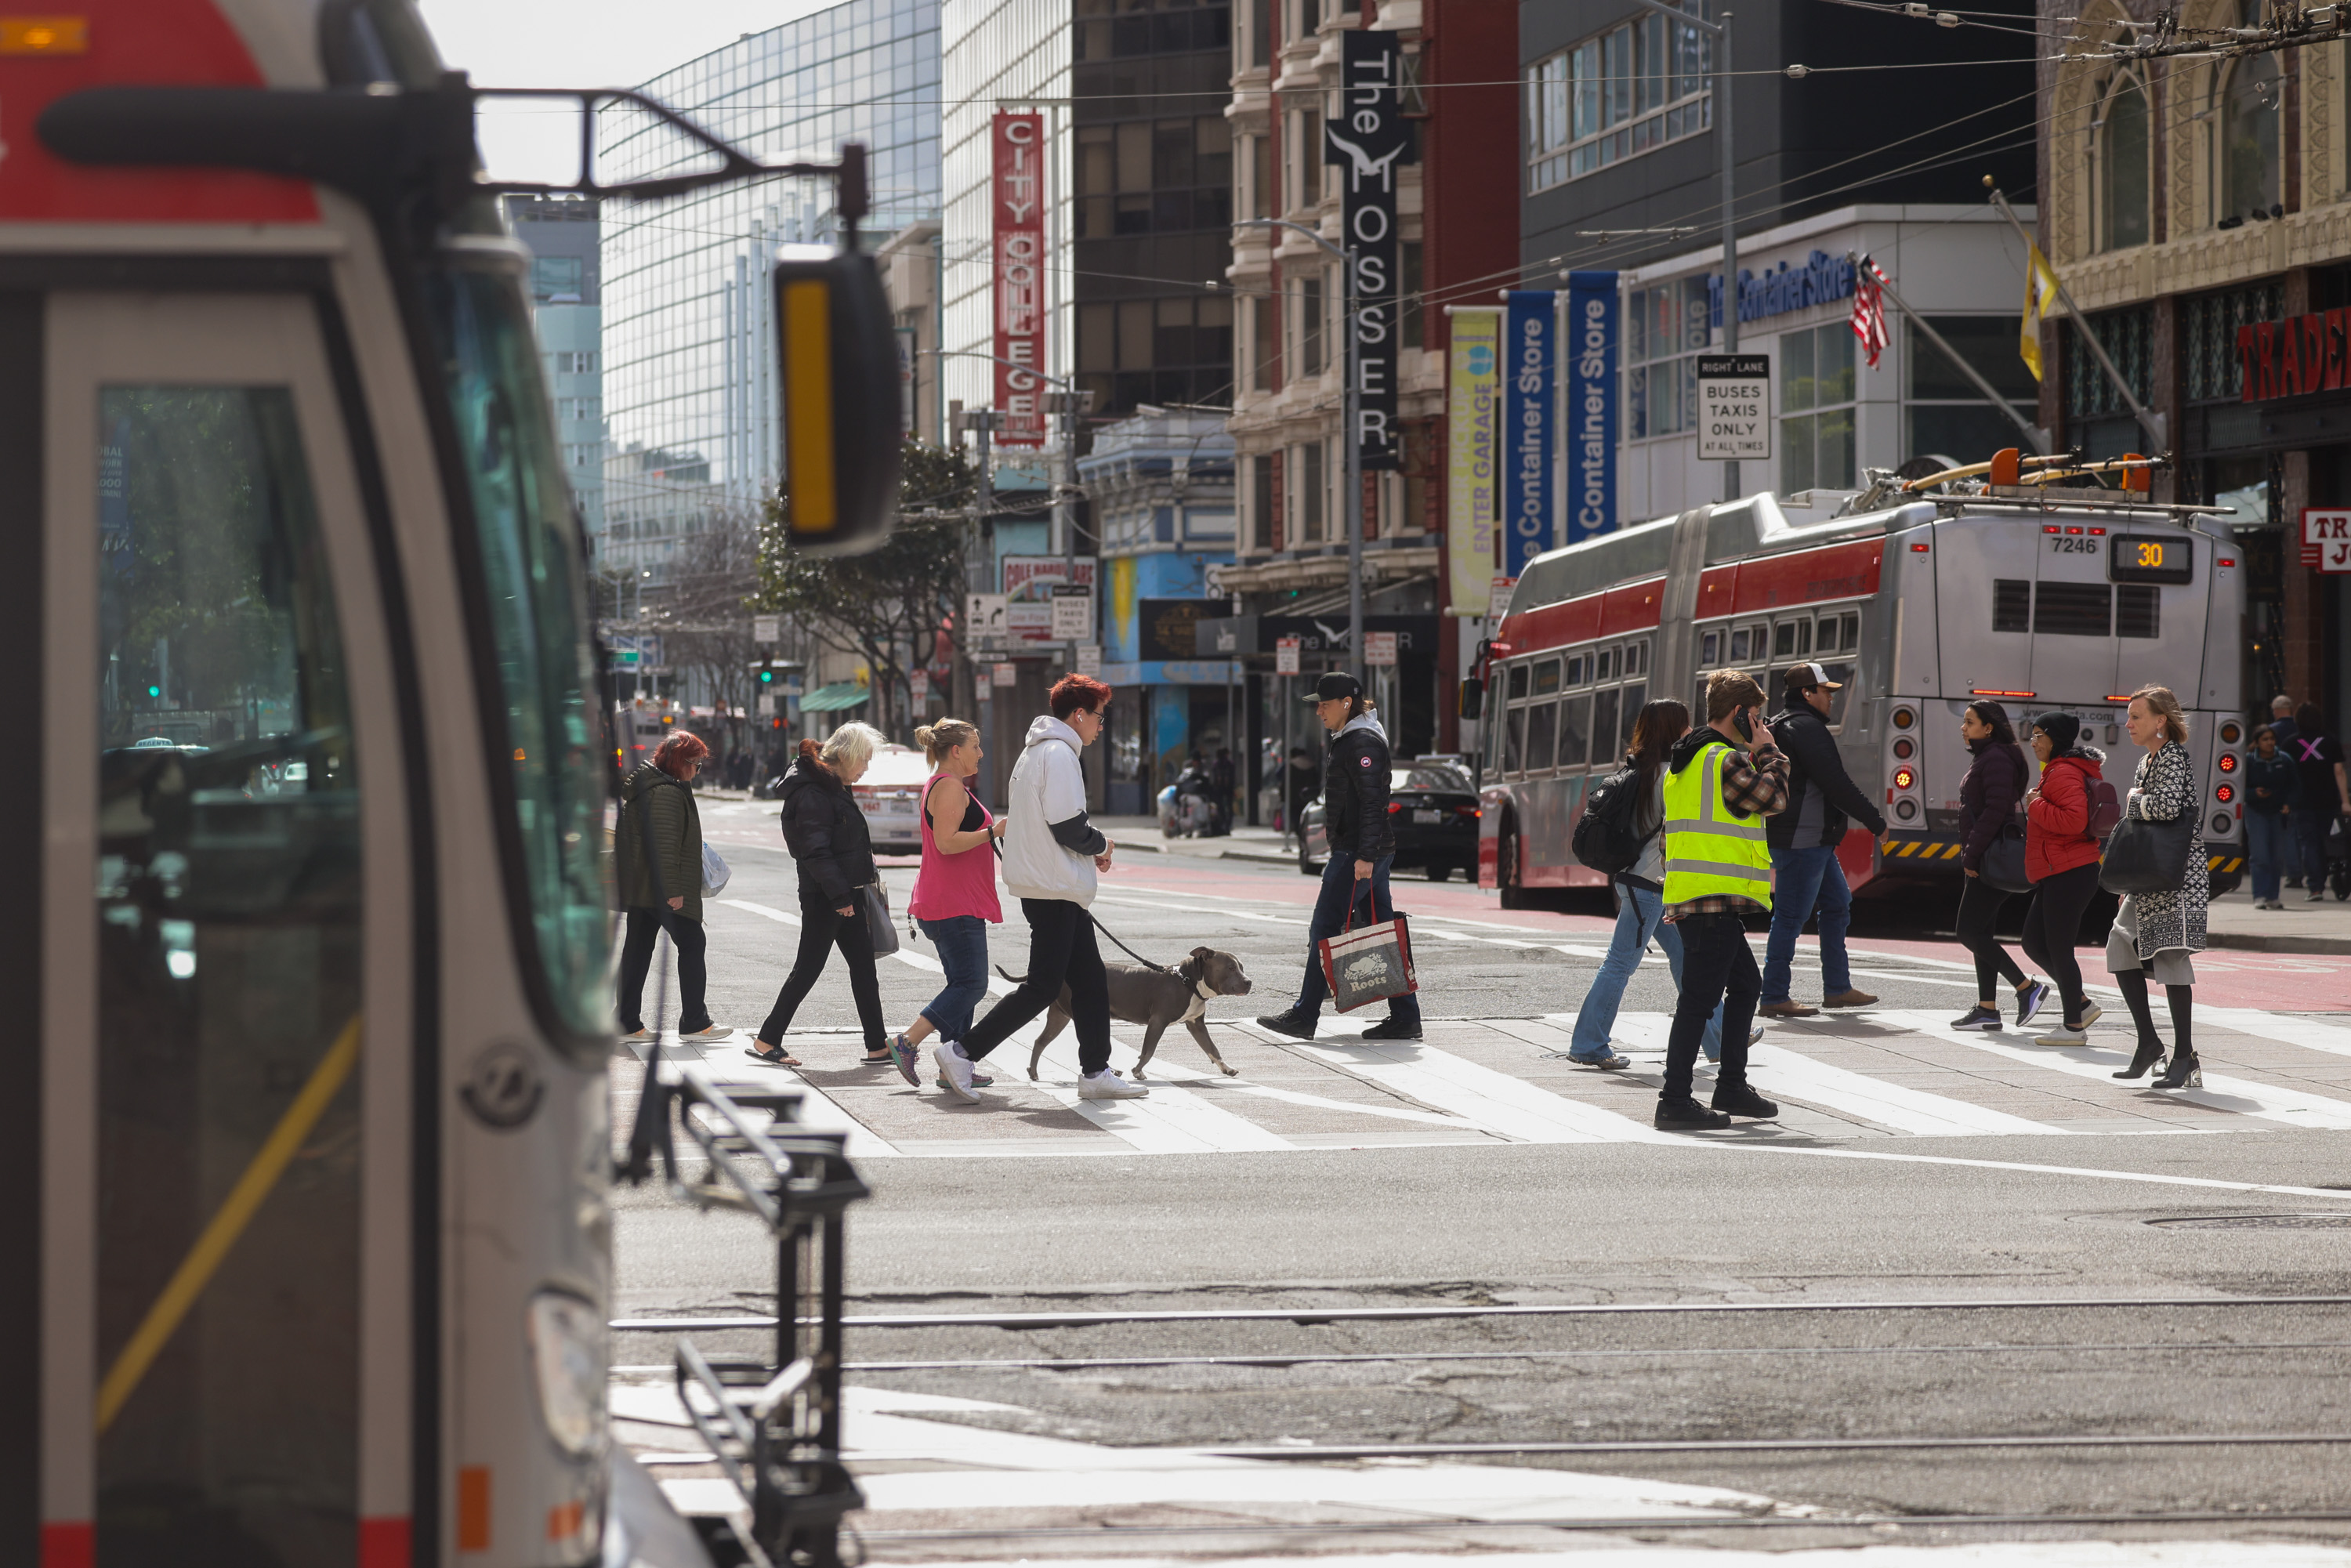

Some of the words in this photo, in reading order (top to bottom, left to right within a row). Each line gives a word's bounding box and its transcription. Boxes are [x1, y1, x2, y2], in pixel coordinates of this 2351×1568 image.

[1353, 49, 1389, 134] The
[1005, 121, 1034, 224] CITY
[1807, 250, 1853, 306] Store
[1005, 237, 1035, 418] COLLEGE
[1519, 318, 1544, 394] Store
[1580, 299, 1606, 379] Store
[1702, 362, 1731, 372] RIGHT
[1737, 362, 1764, 372] LANE
[1707, 386, 1761, 399] BUSES
[1451, 386, 1471, 468] PICKUP
[1473, 383, 1493, 479] GARAGE
[1710, 404, 1758, 417] TAXIS
[1712, 423, 1763, 436] ONLY
[1517, 397, 1543, 538] Container
[1578, 382, 1605, 530] Container
[1705, 442, 1715, 451] AT
[1718, 442, 1733, 451] ALL
[1738, 441, 1763, 451] TIMES
[1451, 475, 1470, 551] ORDER
[1473, 486, 1492, 553] ENTER
[2313, 517, 2351, 539] TR
[2052, 537, 2097, 554] 7246
[2137, 542, 2163, 567] 30
[2330, 543, 2351, 566] J
[1350, 976, 1387, 992] Roots
